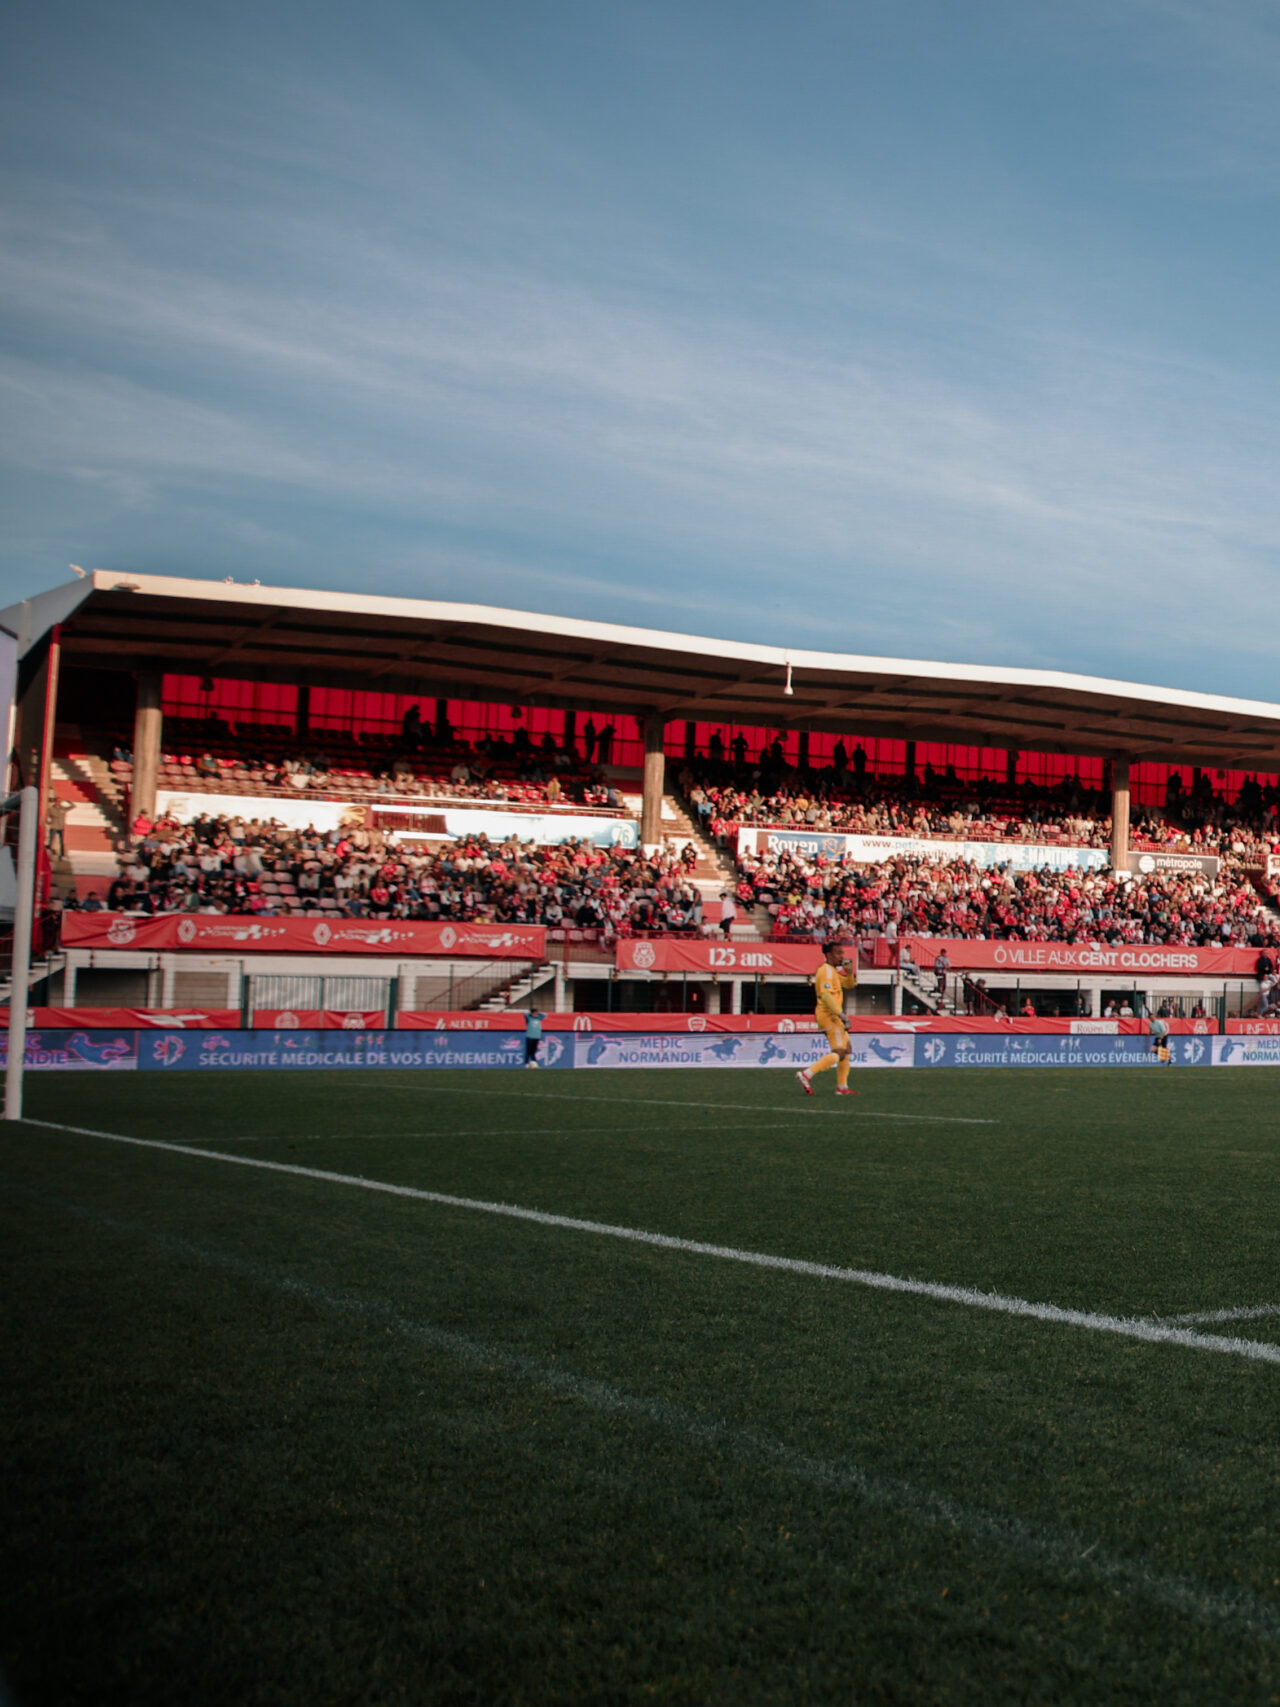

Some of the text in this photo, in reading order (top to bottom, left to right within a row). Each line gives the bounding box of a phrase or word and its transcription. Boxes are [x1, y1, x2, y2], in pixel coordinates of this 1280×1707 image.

[768, 835, 818, 854] Rouen
[1157, 857, 1203, 870] métropole
[709, 947, 773, 968] 125 ans
[994, 945, 1199, 969] Ô VILLE AUX CENT CLOCHERS
[1077, 1021, 1104, 1034] Rouen
[640, 1037, 684, 1049] MEDIC
[199, 1050, 524, 1066] SÉCURITÉ MÉDICALE DE VOS ÉVÉNEMENTS
[618, 1051, 703, 1063] NORMANDIE
[954, 1050, 1009, 1064] SÉCURITÉ
[1010, 1050, 1065, 1064] MÉDICALE
[1068, 1052, 1083, 1063] DE
[1084, 1052, 1107, 1063] VOS
